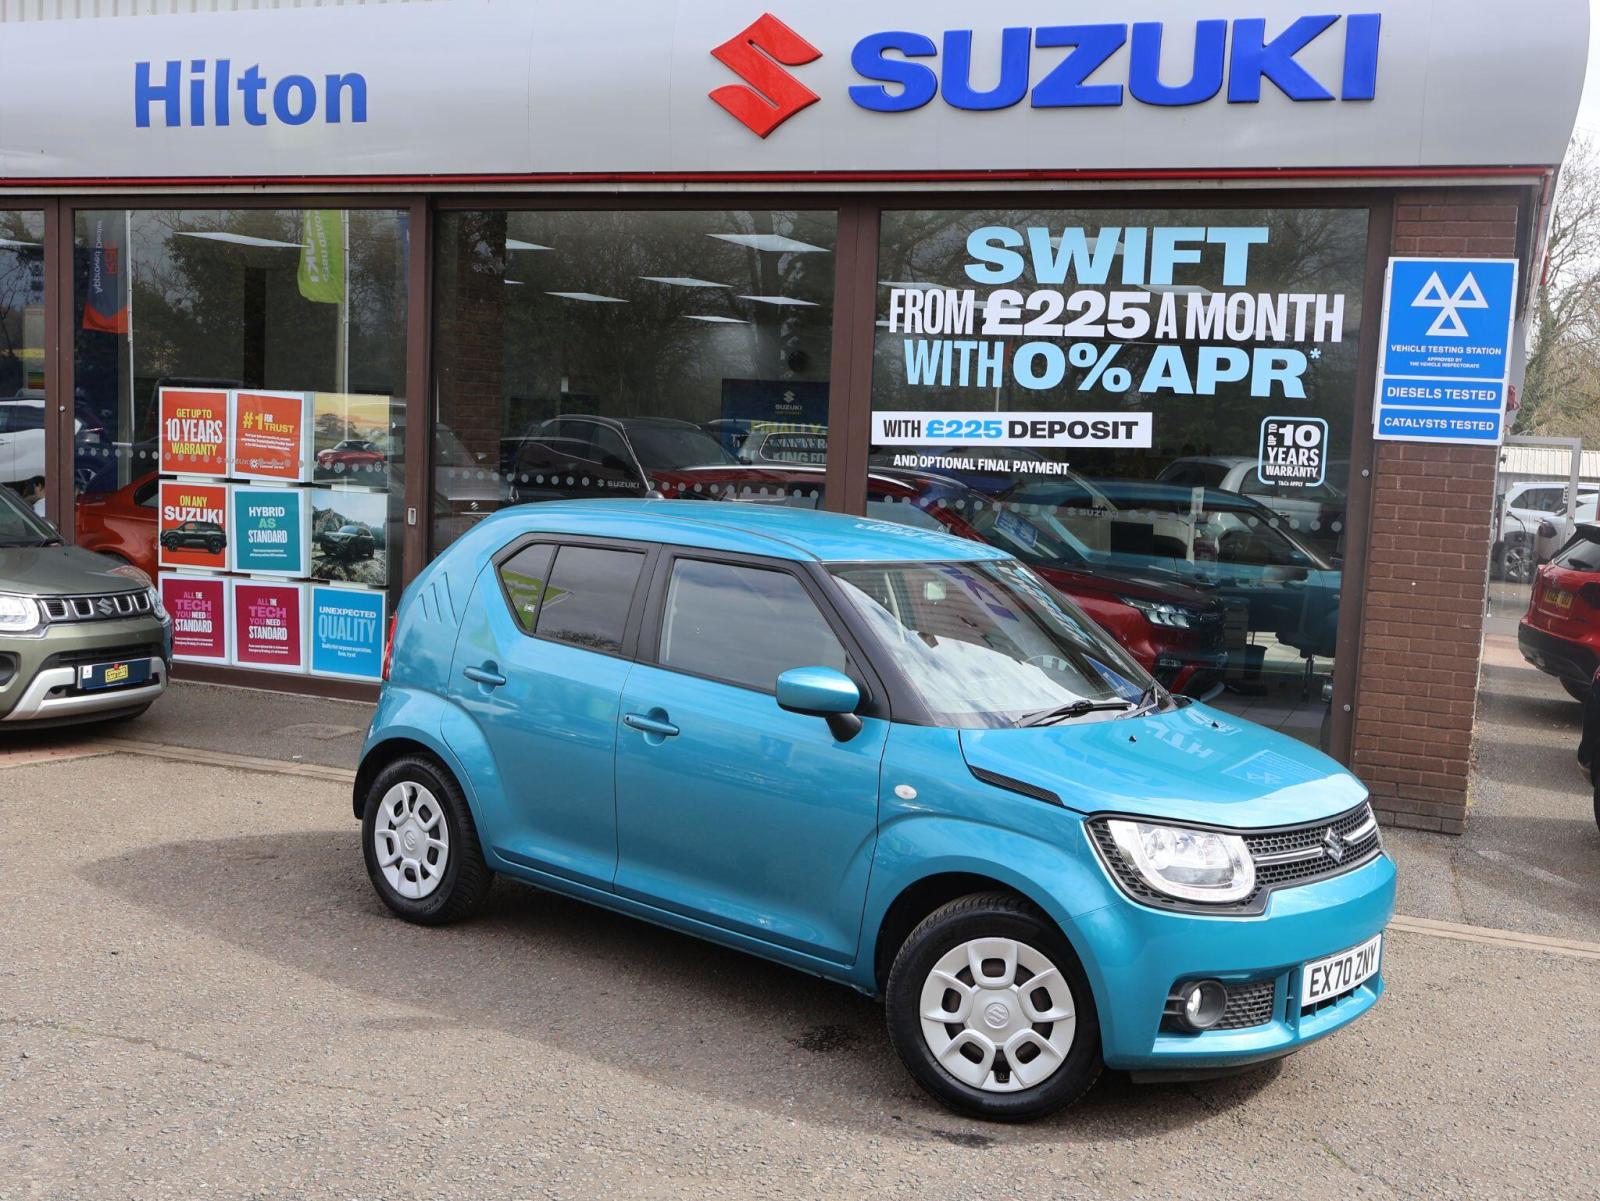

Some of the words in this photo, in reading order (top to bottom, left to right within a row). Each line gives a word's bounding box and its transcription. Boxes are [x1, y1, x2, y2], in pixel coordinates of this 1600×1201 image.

[848, 13, 1382, 113] SUZUKI
[135, 58, 368, 128] Hilton
[964, 226, 1269, 286] SWIFT
[889, 288, 975, 335] FROM
[982, 289, 1151, 338] £225
[1154, 291, 1178, 340] A
[1185, 291, 1346, 343] MONTH
[1391, 344, 1426, 353] VEHICLE
[1428, 345, 1464, 354] TESTING
[1465, 346, 1501, 355] STATION
[904, 339, 1005, 388] WITH
[1012, 341, 1132, 393] 0%
[1387, 387, 1442, 399] DIESELS
[1444, 389, 1497, 400] TESTED
[176, 408, 190, 418] GET
[191, 408, 200, 418] UP
[200, 409, 212, 418] TO
[243, 411, 264, 430] #1
[264, 422, 295, 433] TRUST
[1384, 417, 1447, 429] CATALYSTS
[1450, 420, 1494, 431] TESTED
[166, 418, 181, 442] 10
[181, 419, 223, 444] YEARS
[883, 419, 921, 438] WITH
[926, 419, 1003, 438] £225
[1008, 420, 1139, 440] DEPOSIT
[1268, 423, 1278, 433] TO
[1267, 434, 1277, 446] UP
[1278, 424, 1321, 448] 10
[171, 442, 217, 456] WARRANTY
[1267, 446, 1319, 467] YEARS
[893, 454, 918, 468] AND
[919, 456, 976, 471] OPTIONAL
[977, 459, 1011, 473] FINAL
[1012, 461, 1069, 475] PAYMENT
[1265, 465, 1318, 478] WARRANTY
[607, 480, 640, 489] SUZUKI
[1290, 480, 1303, 488] APPLY
[179, 495, 191, 506] ON
[192, 496, 208, 507] ANY
[164, 506, 223, 523] SUZUKI
[248, 506, 285, 517] HYBRID
[258, 518, 276, 529] AS
[248, 530, 288, 544] STANDARD
[175, 599, 212, 611] TECH
[257, 598, 269, 606] ALL
[192, 611, 206, 619] NEED
[249, 605, 287, 618] TECH
[319, 606, 377, 619] UNEXPECTED
[175, 618, 212, 633] STANDARD
[250, 617, 265, 625] YOU
[266, 618, 280, 626] NEED
[248, 626, 288, 640] STANDARD
[318, 615, 376, 643] QUALITY
[1309, 957, 1352, 998] EX70
[1354, 942, 1378, 981] ZNY
